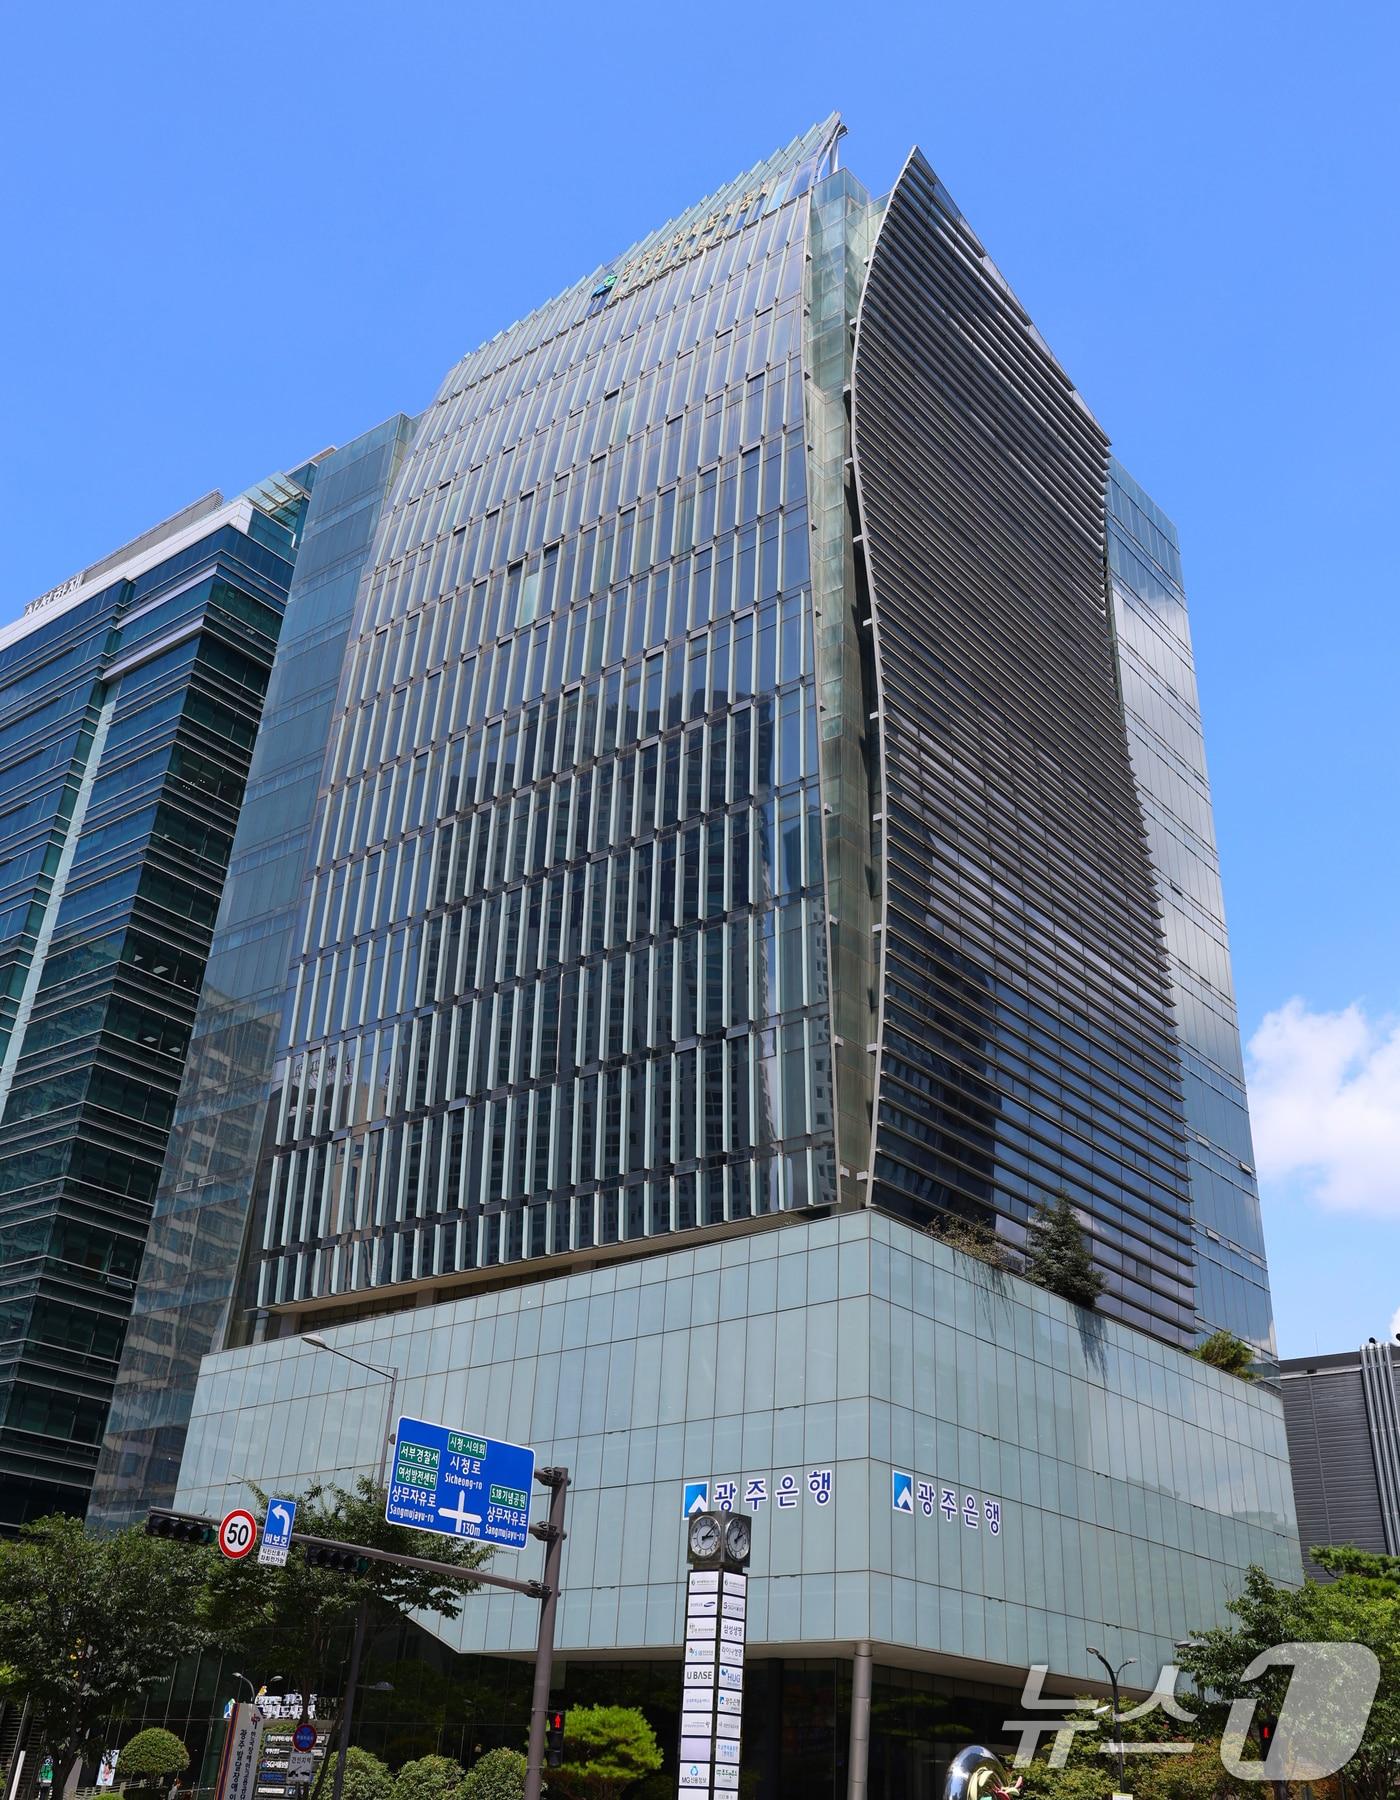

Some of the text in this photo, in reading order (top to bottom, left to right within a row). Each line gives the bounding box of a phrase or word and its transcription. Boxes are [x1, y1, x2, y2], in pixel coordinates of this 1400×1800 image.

[400, 1448, 439, 1464] 서부경찰서
[450, 1456, 481, 1475] 시청로
[398, 1466, 436, 1486] 여성발전센터
[444, 1472, 483, 1490] Sicheong-ro
[391, 1485, 436, 1508] 상무자유로
[713, 1470, 832, 1512] 광주은행
[389, 1503, 435, 1523] Sangmujayu-ro
[487, 1506, 527, 1527] 상무자유로
[917, 1480, 1001, 1536] 광주은행
[227, 1523, 249, 1546] 50
[462, 1522, 481, 1537] 130m
[485, 1523, 525, 1542] Sangmujayu-ro
[265, 1533, 288, 1547] 비보호
[727, 1673, 741, 1683] HUG
